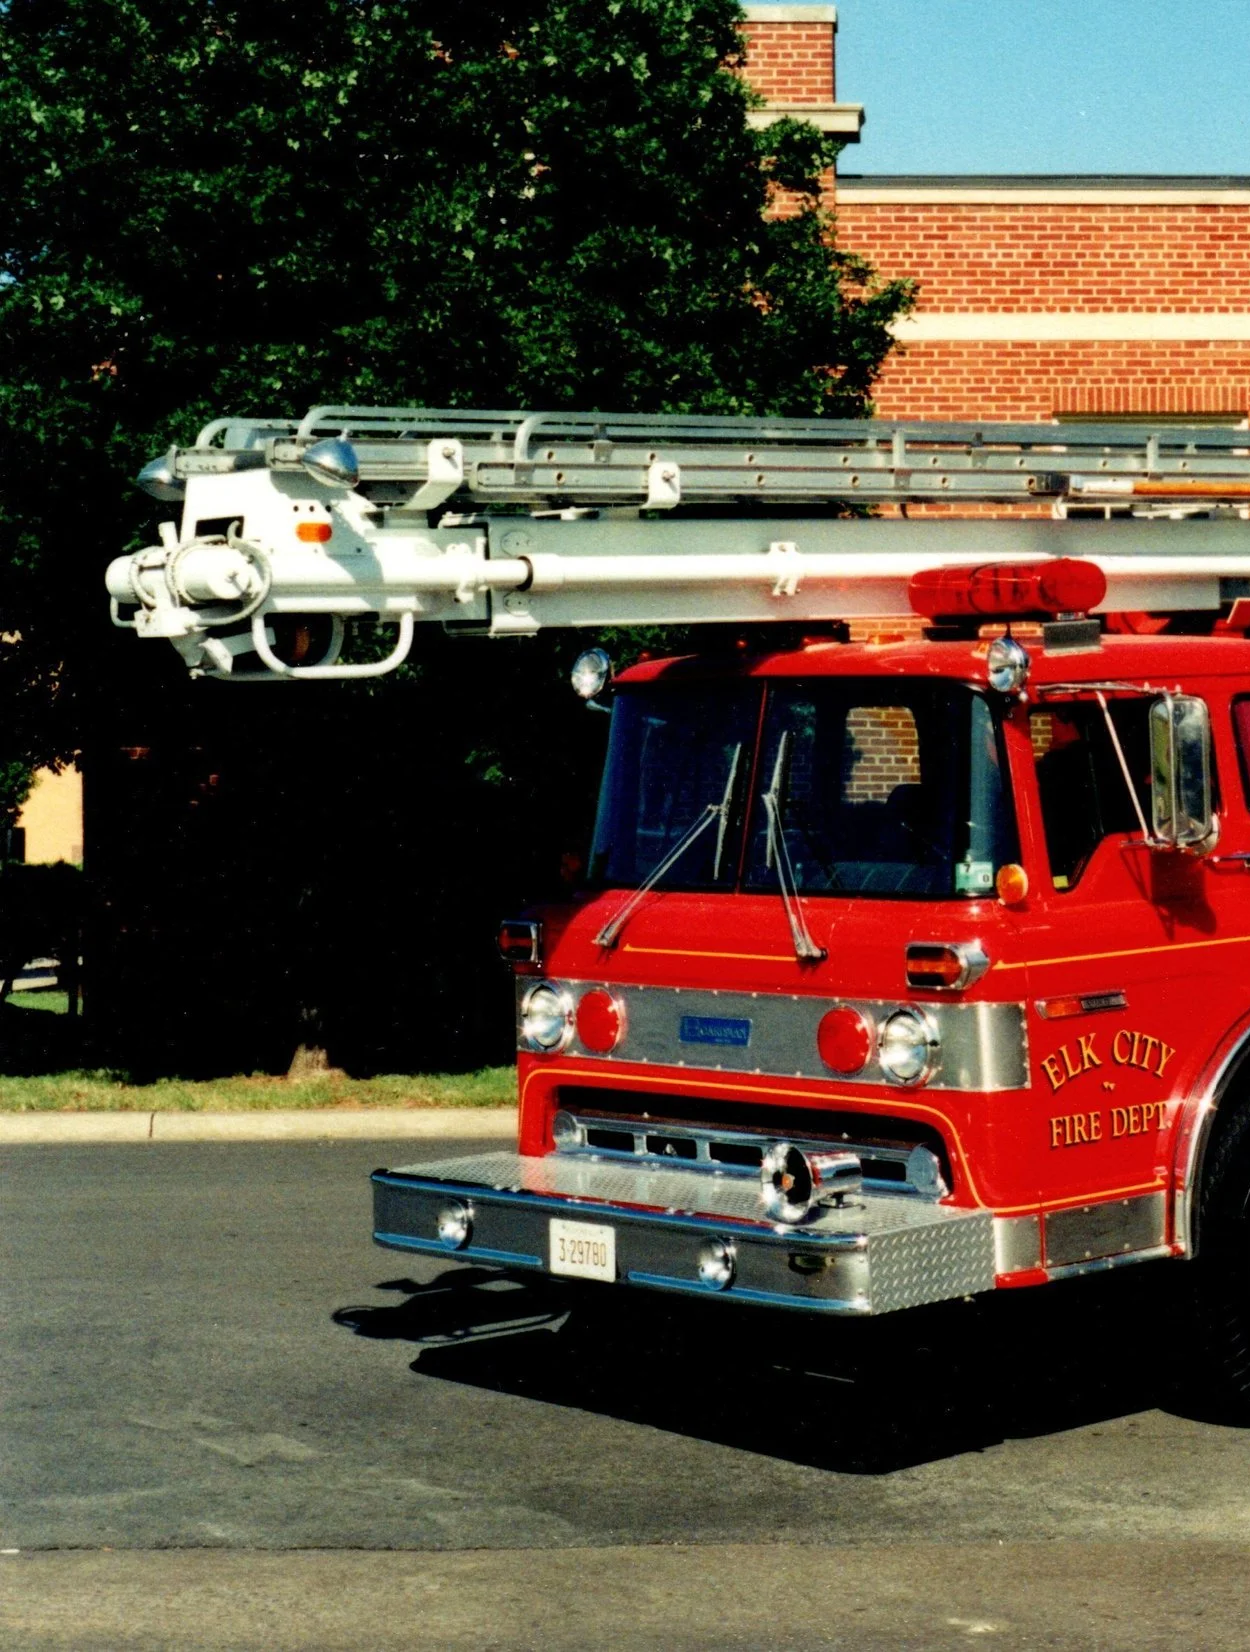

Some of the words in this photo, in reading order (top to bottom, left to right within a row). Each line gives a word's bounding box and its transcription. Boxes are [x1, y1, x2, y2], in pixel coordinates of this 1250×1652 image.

[1041, 1033, 1103, 1092] ELK
[1112, 1028, 1177, 1079] CITY
[1050, 1110, 1103, 1149] FIRE
[1111, 1100, 1173, 1139] DEPT.
